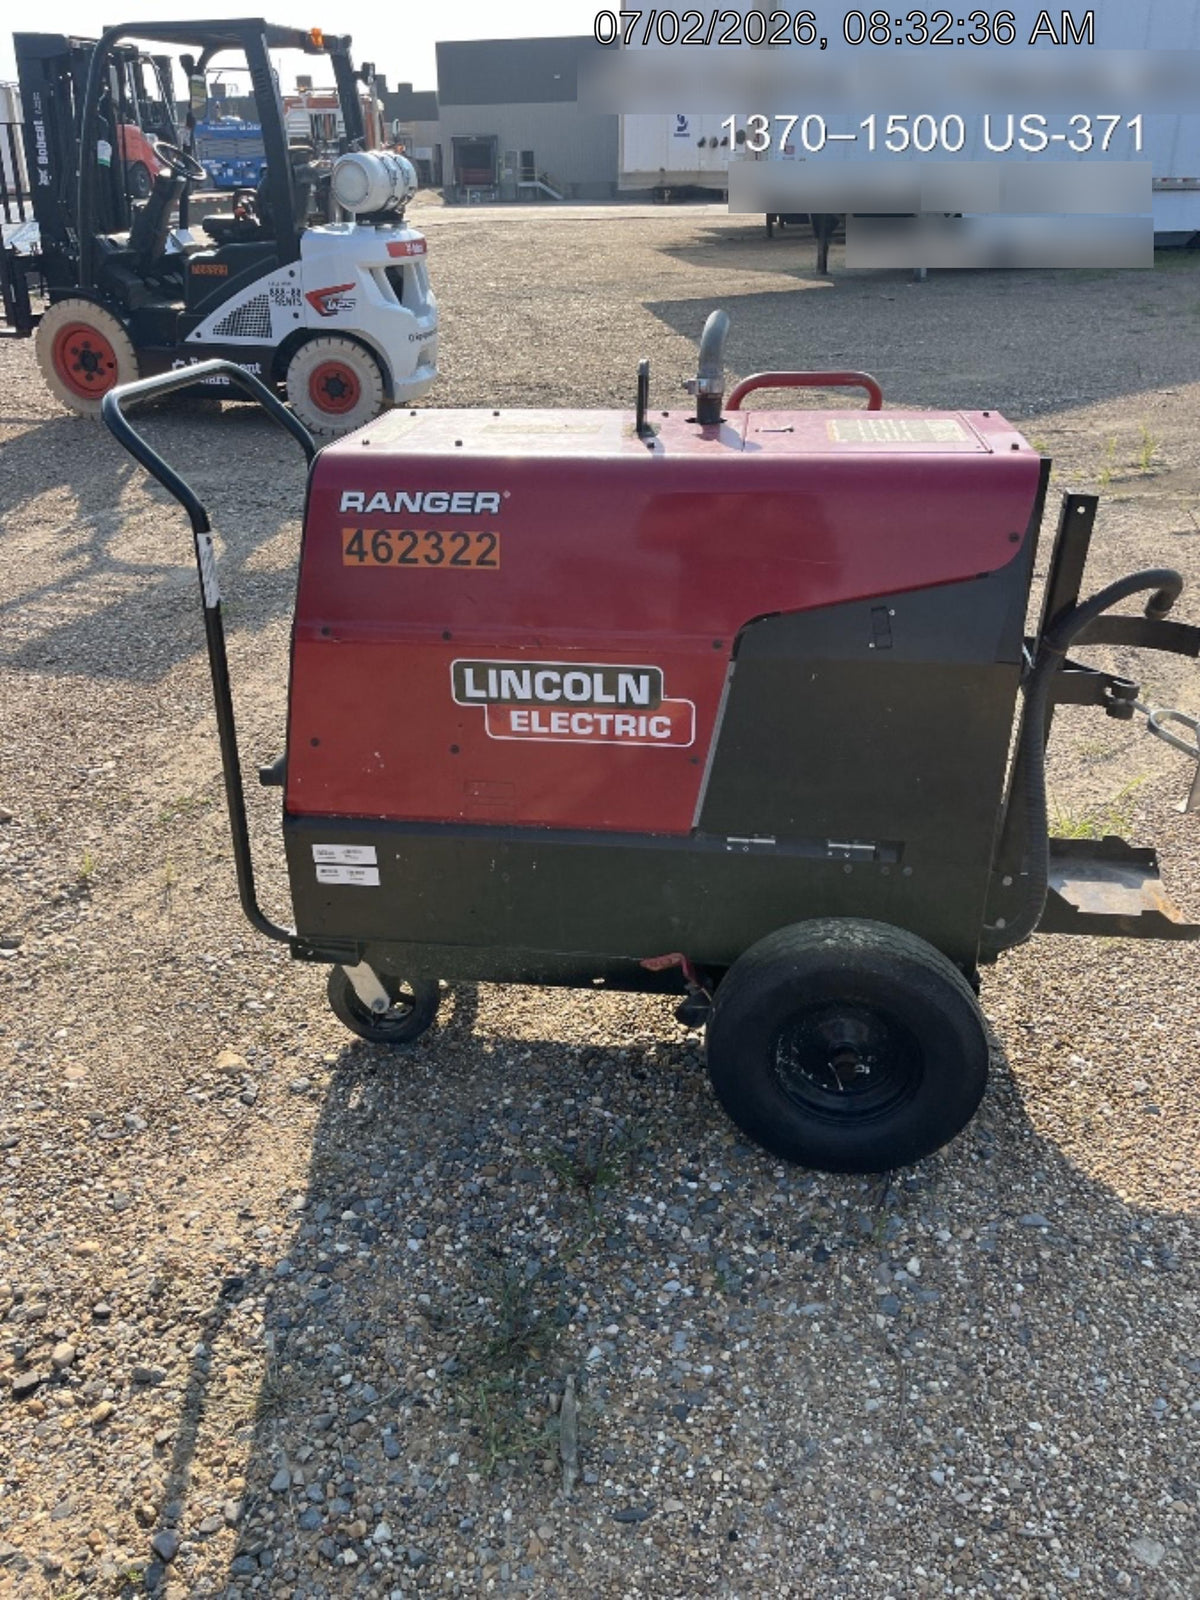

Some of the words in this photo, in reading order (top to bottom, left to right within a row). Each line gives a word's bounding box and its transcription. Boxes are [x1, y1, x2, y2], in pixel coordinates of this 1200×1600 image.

[33, 120, 48, 164] Bobcat
[339, 490, 501, 514] RANGER
[344, 528, 498, 567] 462322
[463, 667, 650, 705] LINCOLN
[509, 710, 672, 739] ELECTRIC
